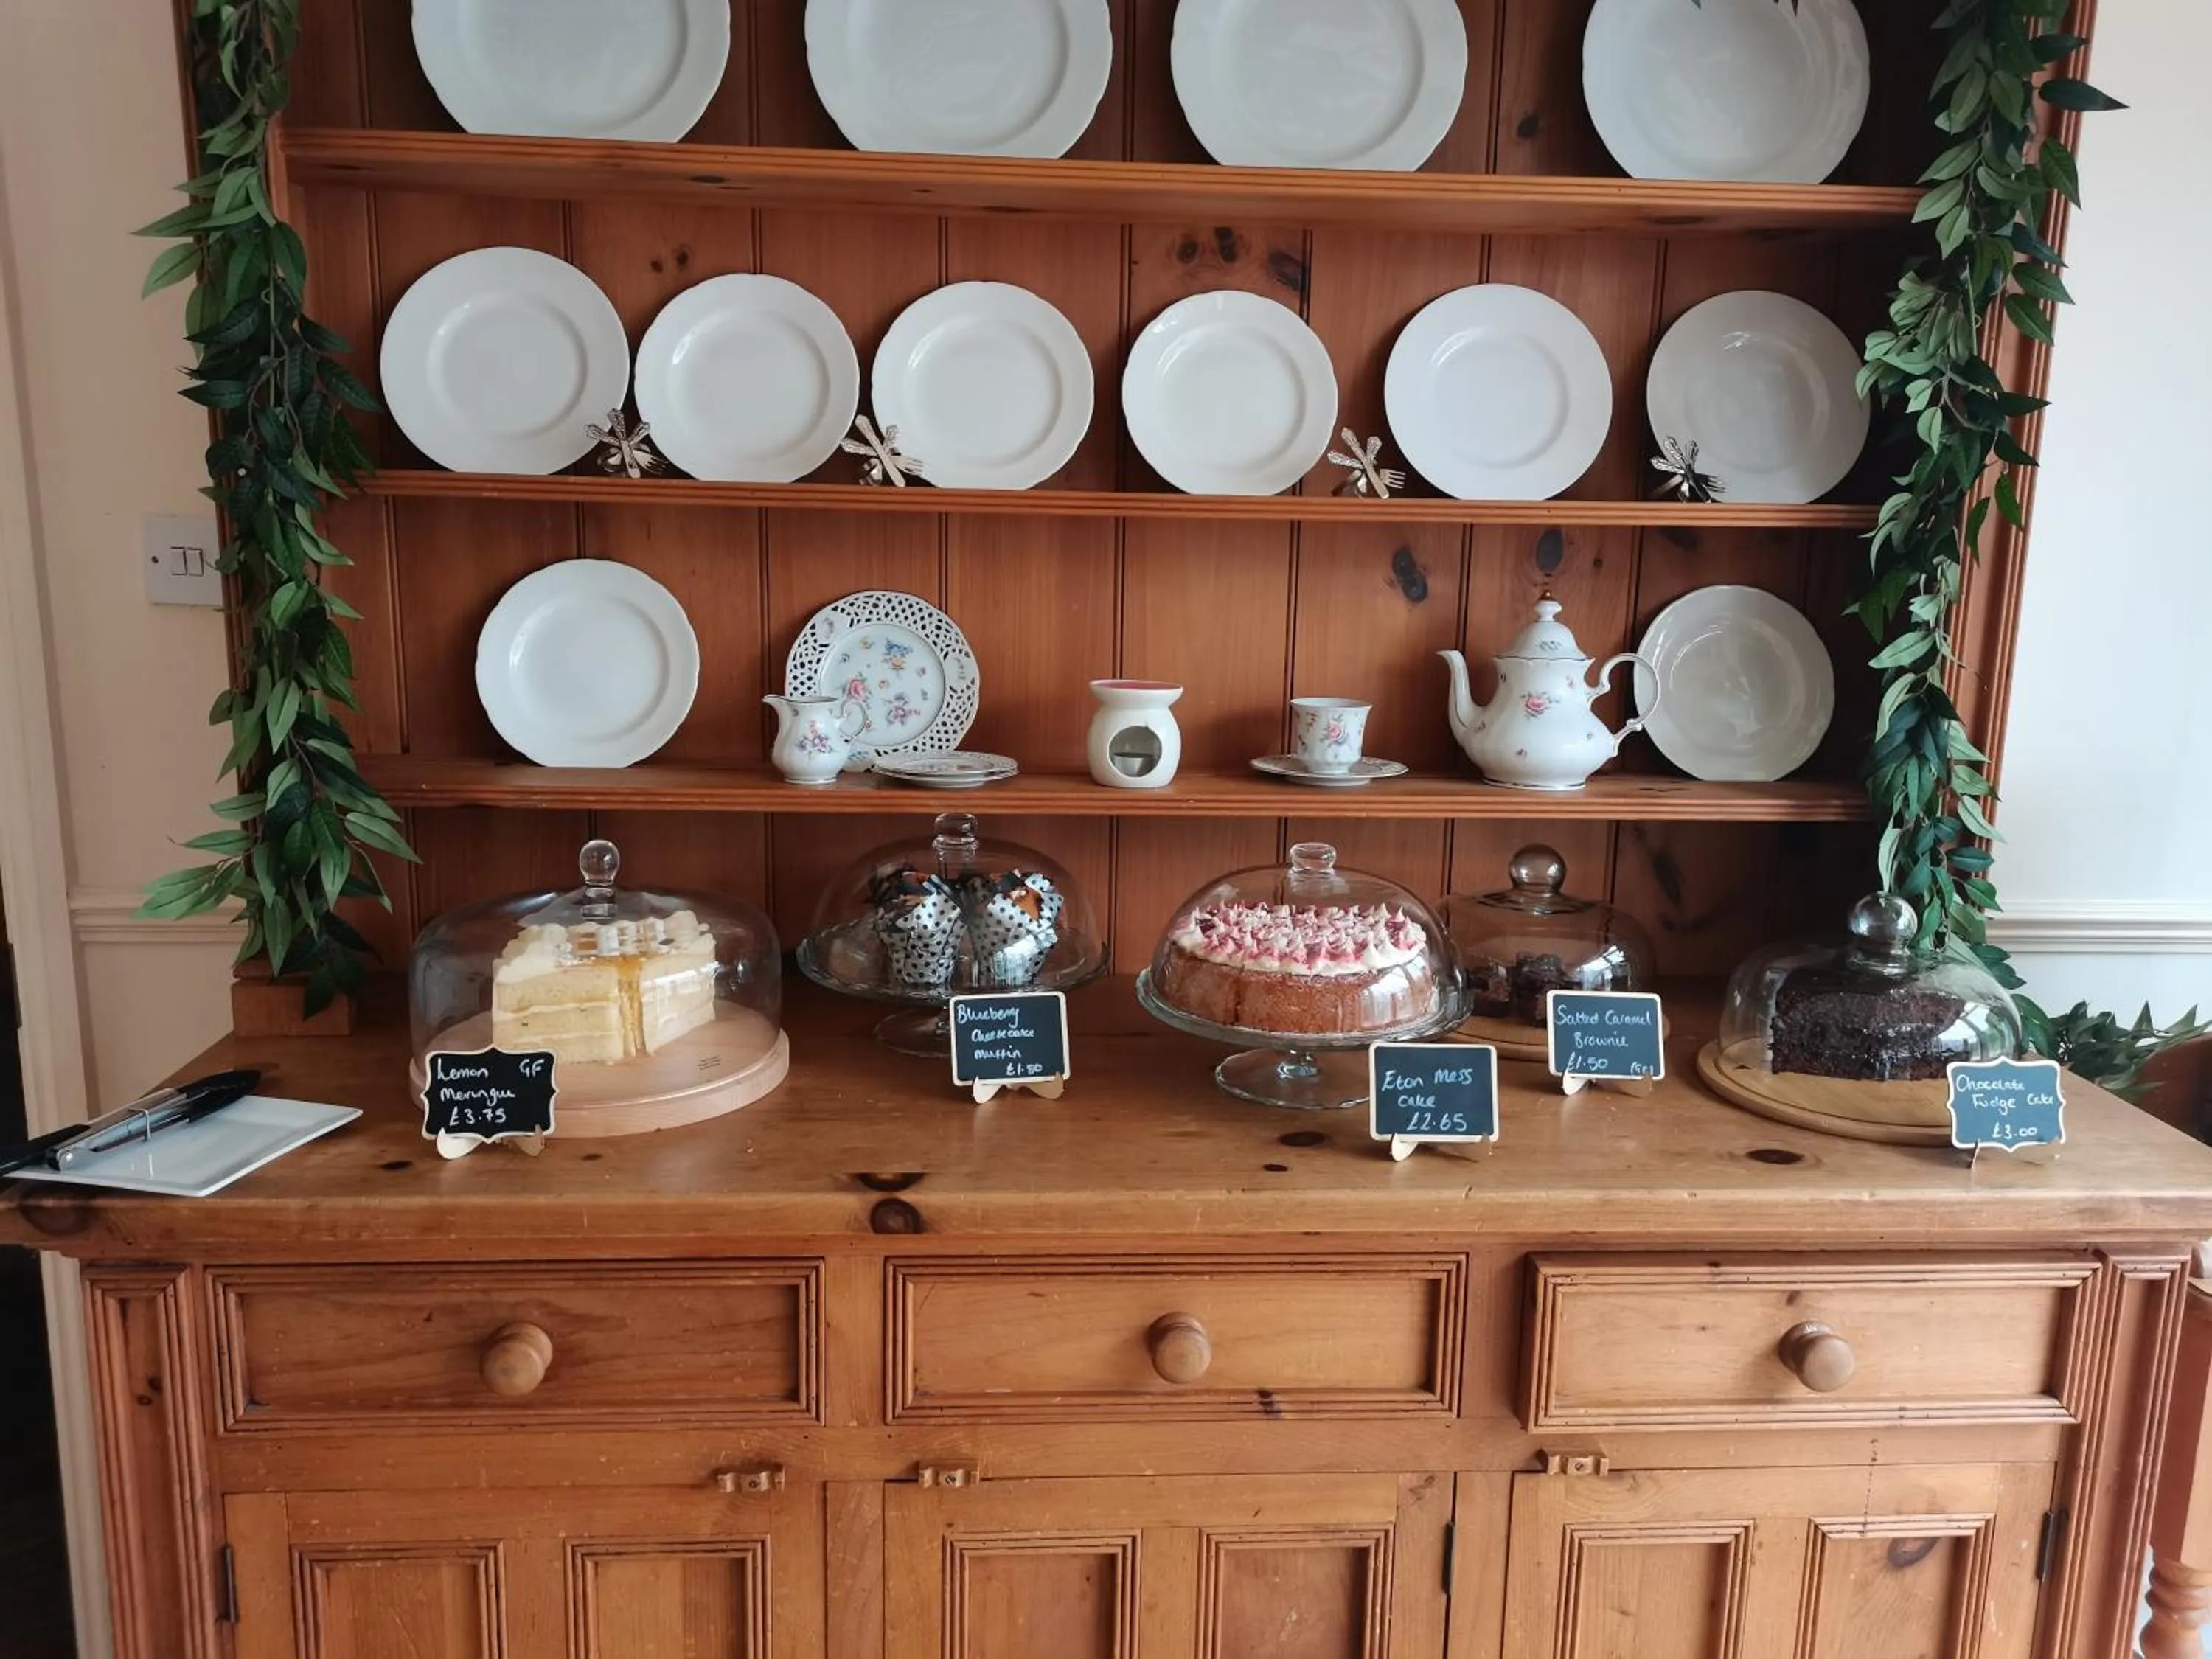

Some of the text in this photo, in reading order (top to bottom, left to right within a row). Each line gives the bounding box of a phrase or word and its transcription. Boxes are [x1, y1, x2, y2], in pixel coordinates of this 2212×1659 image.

[437, 1057, 489, 1081] Lemon
[519, 1058, 544, 1078] GF
[1381, 1070, 1424, 1092] Eton
[1972, 1093, 2017, 1116] Fudge
[449, 1106, 507, 1126] £3.75
[1407, 1111, 1467, 1132] £2.65
[1992, 1121, 2037, 1140] £3.00
